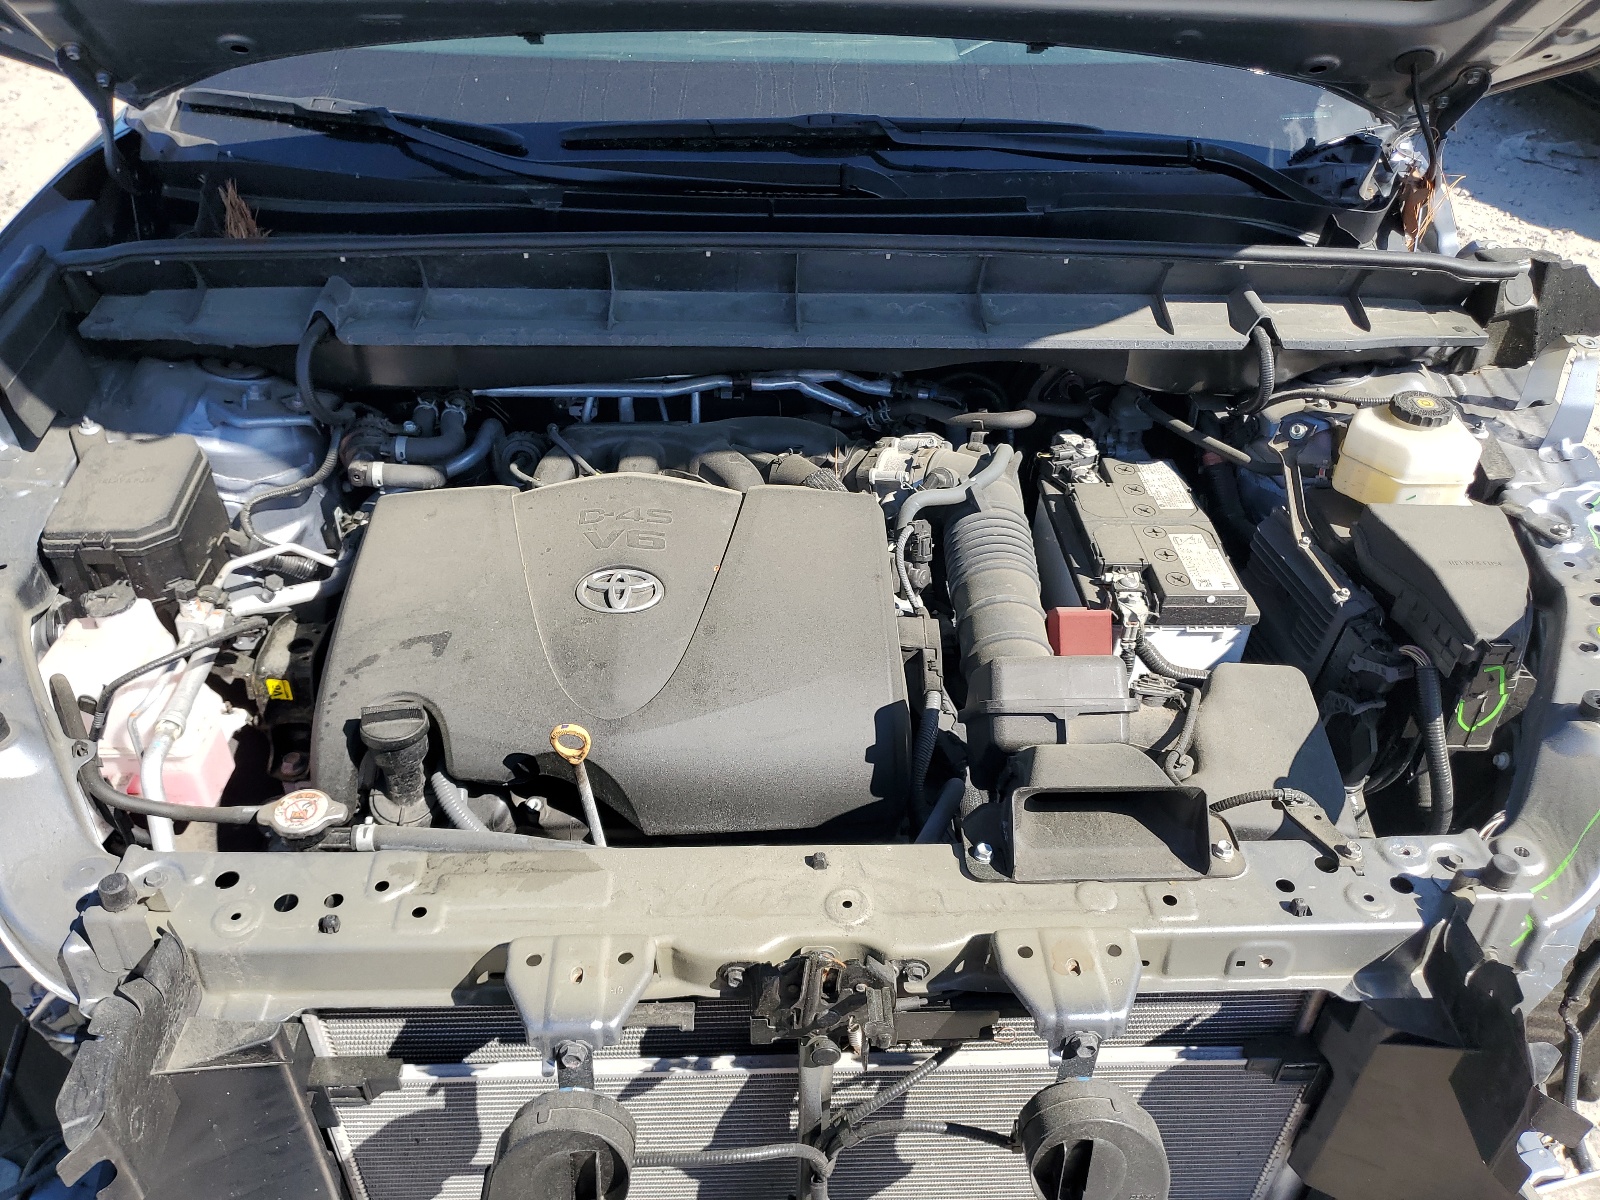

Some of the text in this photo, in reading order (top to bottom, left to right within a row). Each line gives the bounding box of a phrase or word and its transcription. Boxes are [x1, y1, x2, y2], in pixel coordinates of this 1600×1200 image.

[578, 507, 673, 525] D-4S
[583, 528, 667, 551] V6
[272, 684, 283, 696] V6
